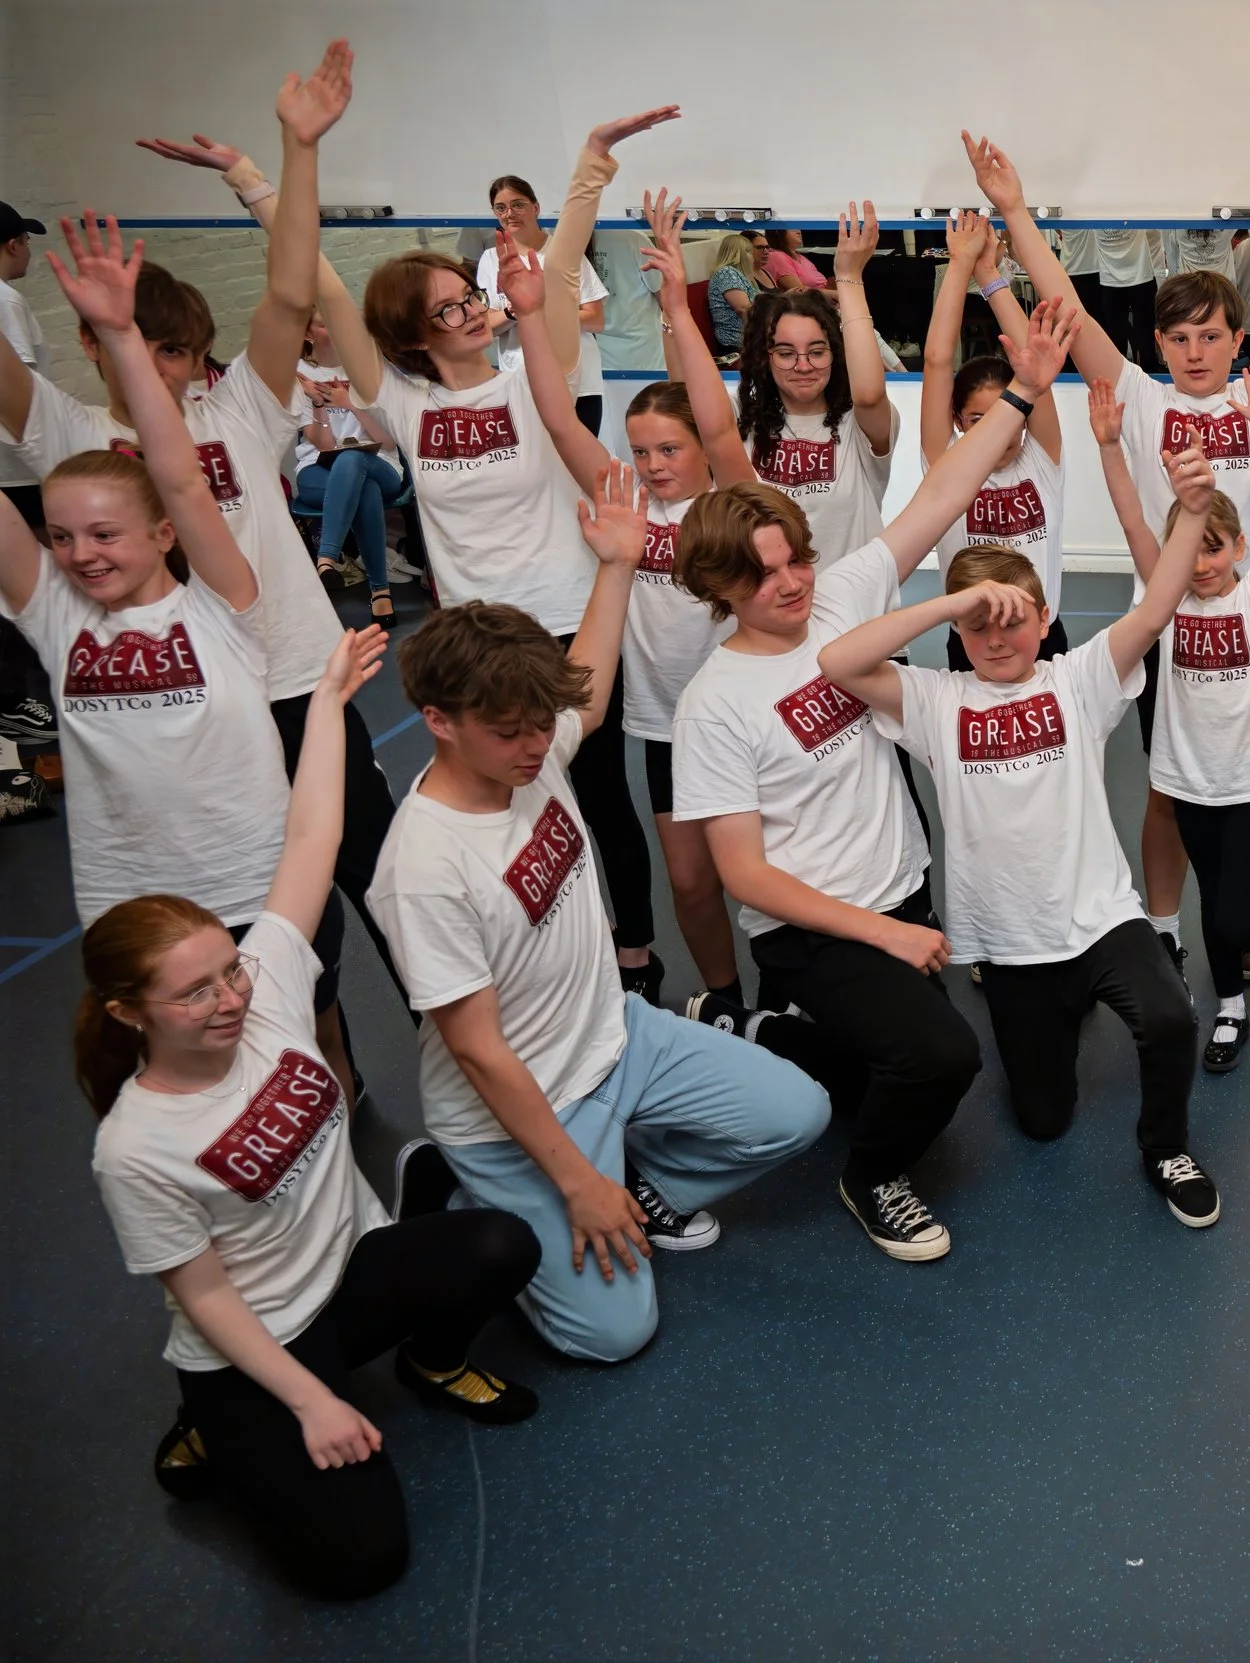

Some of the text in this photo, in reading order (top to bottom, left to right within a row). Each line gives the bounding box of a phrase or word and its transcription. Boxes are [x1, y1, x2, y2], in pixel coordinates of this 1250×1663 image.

[430, 419, 508, 447] GEASE
[487, 448, 518, 464] 2025
[1225, 459, 1249, 470] 2025
[805, 483, 831, 495] 2025
[218, 500, 242, 512] 25
[645, 533, 675, 560] REA
[635, 571, 674, 586] SYTCo
[1175, 626, 1243, 656] REASE
[71, 637, 194, 678] GREASE
[113, 678, 174, 690] MUSICAL
[186, 673, 198, 683] 59
[1219, 668, 1248, 682] 2025
[64, 689, 206, 713] DOSYTCo 2025
[796, 685, 818, 703] WE GO
[792, 685, 852, 733] GREA
[984, 711, 995, 720] WE
[822, 722, 838, 736] THE
[969, 705, 1058, 747] GREASE
[984, 749, 1000, 758] THE
[1003, 740, 1044, 757] MUSICAL
[1051, 734, 1061, 744] 59
[963, 747, 1065, 775] DOSYTCo 2025
[521, 812, 577, 903] GREASE
[228, 1128, 246, 1143] WE
[255, 1073, 292, 1117] TOGETHER
[226, 1064, 329, 1182] GREASE
[261, 1133, 328, 1208] DOSYTCo
[272, 1153, 293, 1175] THE
